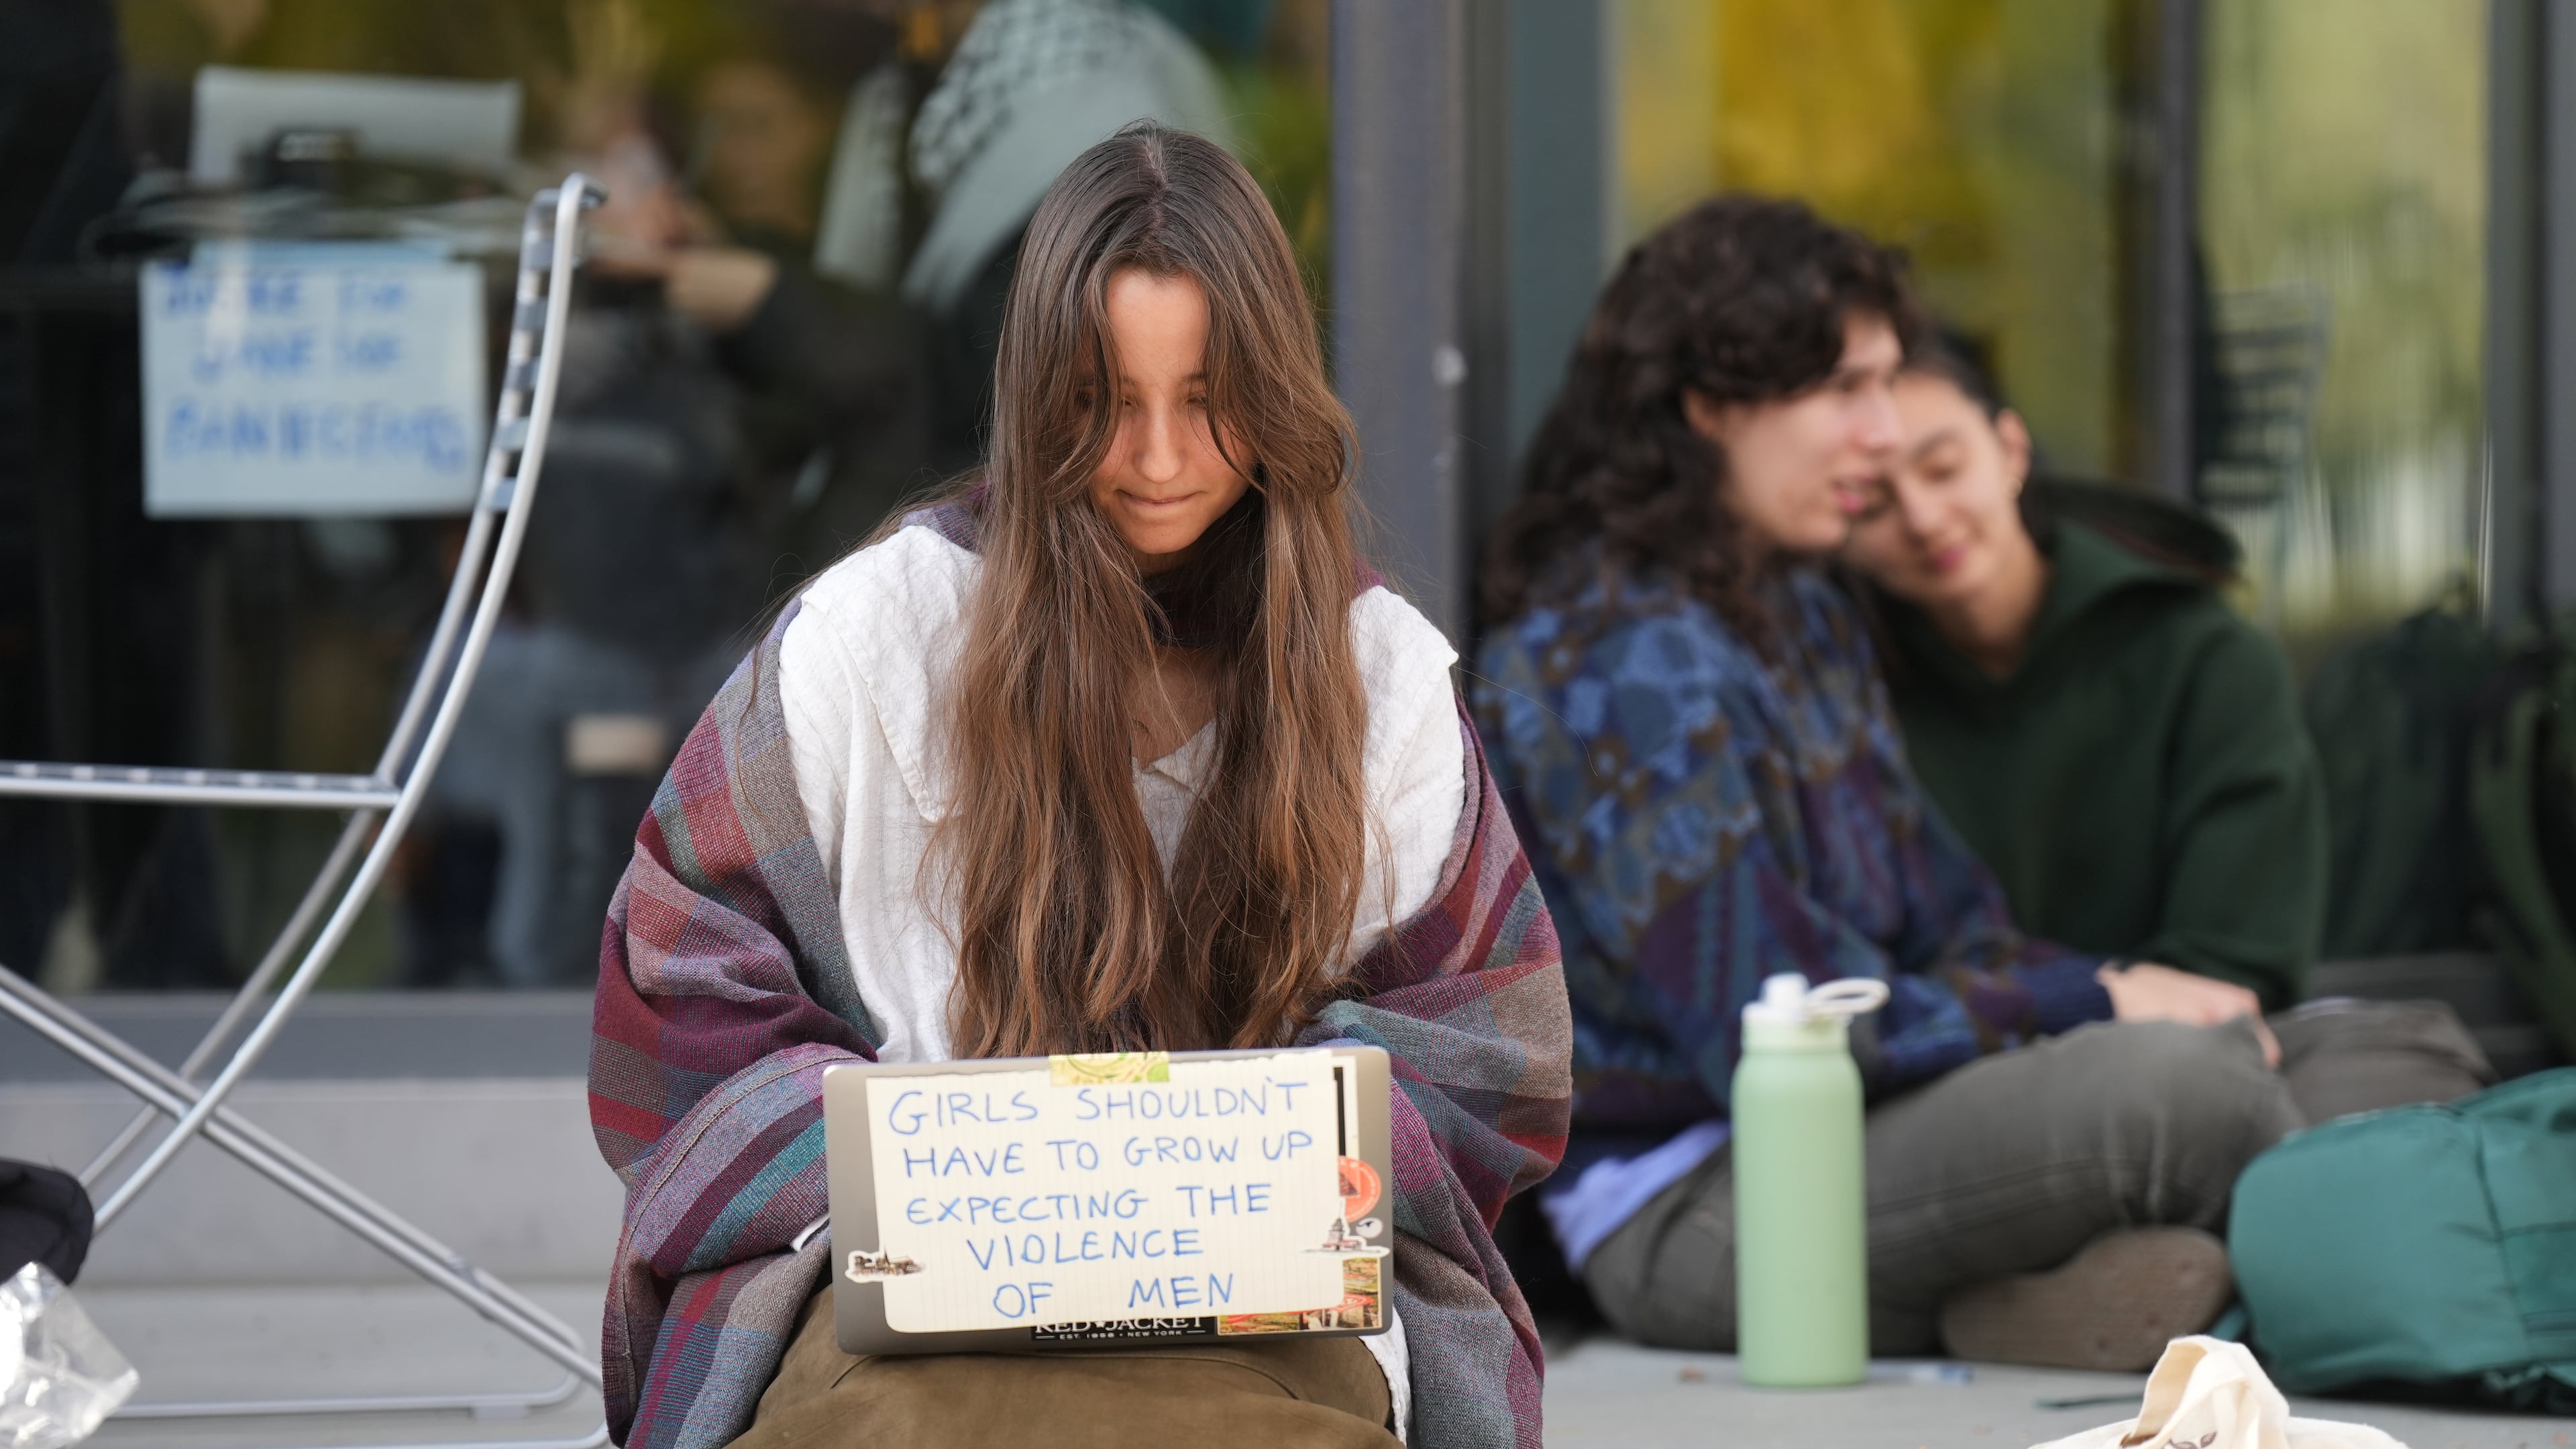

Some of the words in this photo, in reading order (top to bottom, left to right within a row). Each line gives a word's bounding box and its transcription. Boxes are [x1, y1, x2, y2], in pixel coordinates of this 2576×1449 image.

[889, 1091, 1039, 1136] GIRLS
[1076, 1076, 1309, 1122] SHOULDN'T
[904, 1142, 1024, 1178] HAVE
[1046, 1139, 1100, 1171] TO
[1124, 1136, 1238, 1167] GROW
[1263, 1130, 1313, 1161] UP
[906, 1189, 1149, 1226] EXPECTING
[1177, 1183, 1272, 1218] THE
[966, 1228, 1205, 1271] VIOLENCE
[992, 1281, 1055, 1320] OF
[1128, 1273, 1234, 1309] MEN
